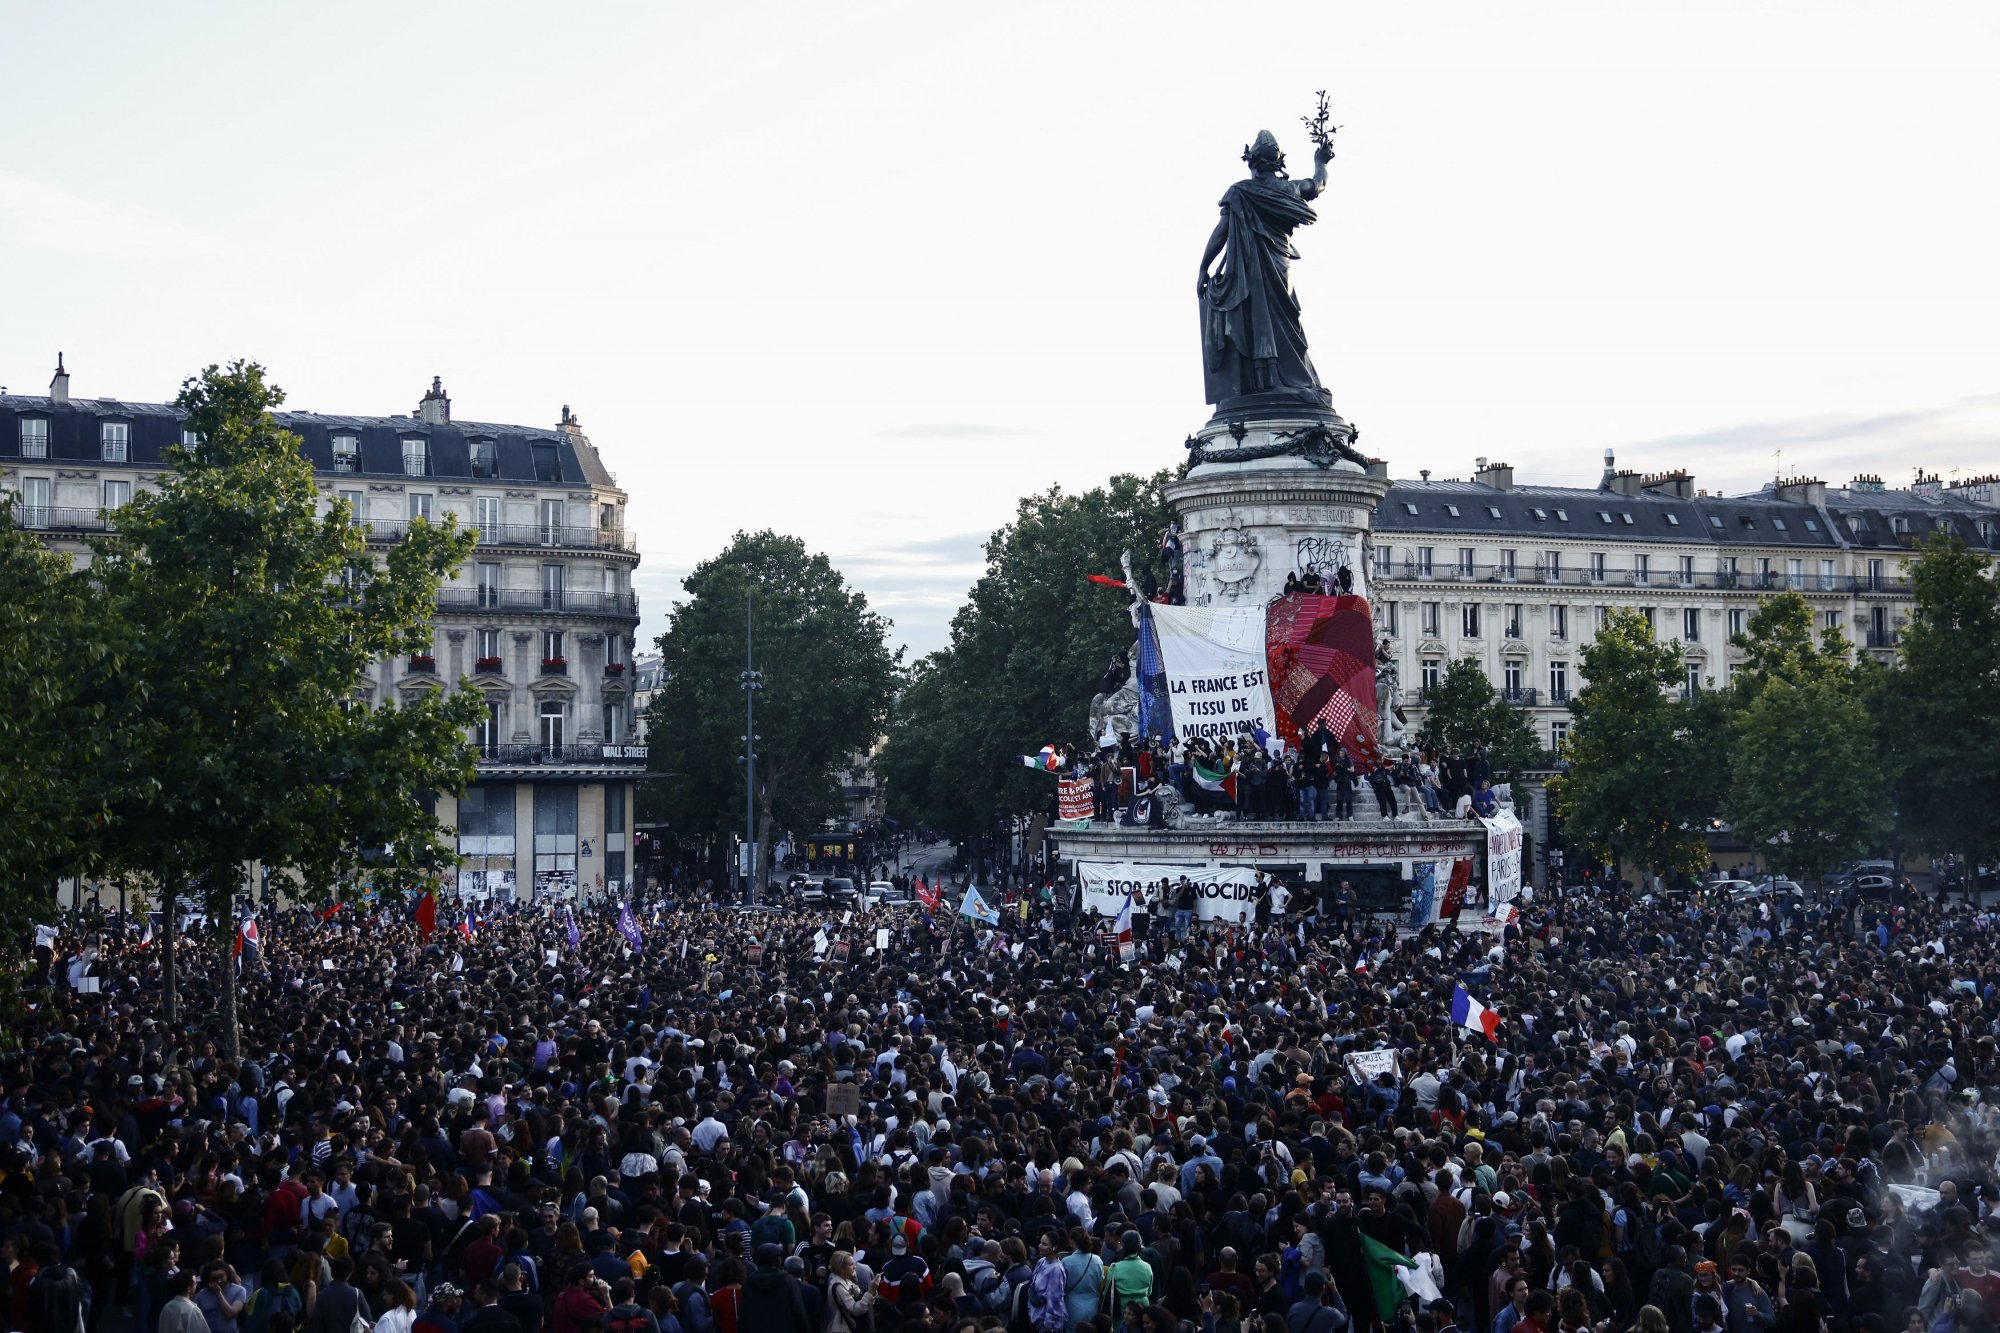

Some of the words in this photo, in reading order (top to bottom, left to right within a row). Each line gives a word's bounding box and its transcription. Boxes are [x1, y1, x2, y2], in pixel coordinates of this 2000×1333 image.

[1171, 680, 1187, 693] LA
[1192, 676, 1238, 693] FRANCE
[1243, 671, 1264, 688] EST
[1189, 700, 1225, 715] TISSU
[1232, 697, 1248, 712] DE
[1183, 717, 1264, 738] MIGRATIONS
[603, 746, 622, 758] WALL
[624, 746, 648, 758] STREET
[1107, 880, 1142, 896] STOP
[1171, 881, 1258, 903] NOCIDE
